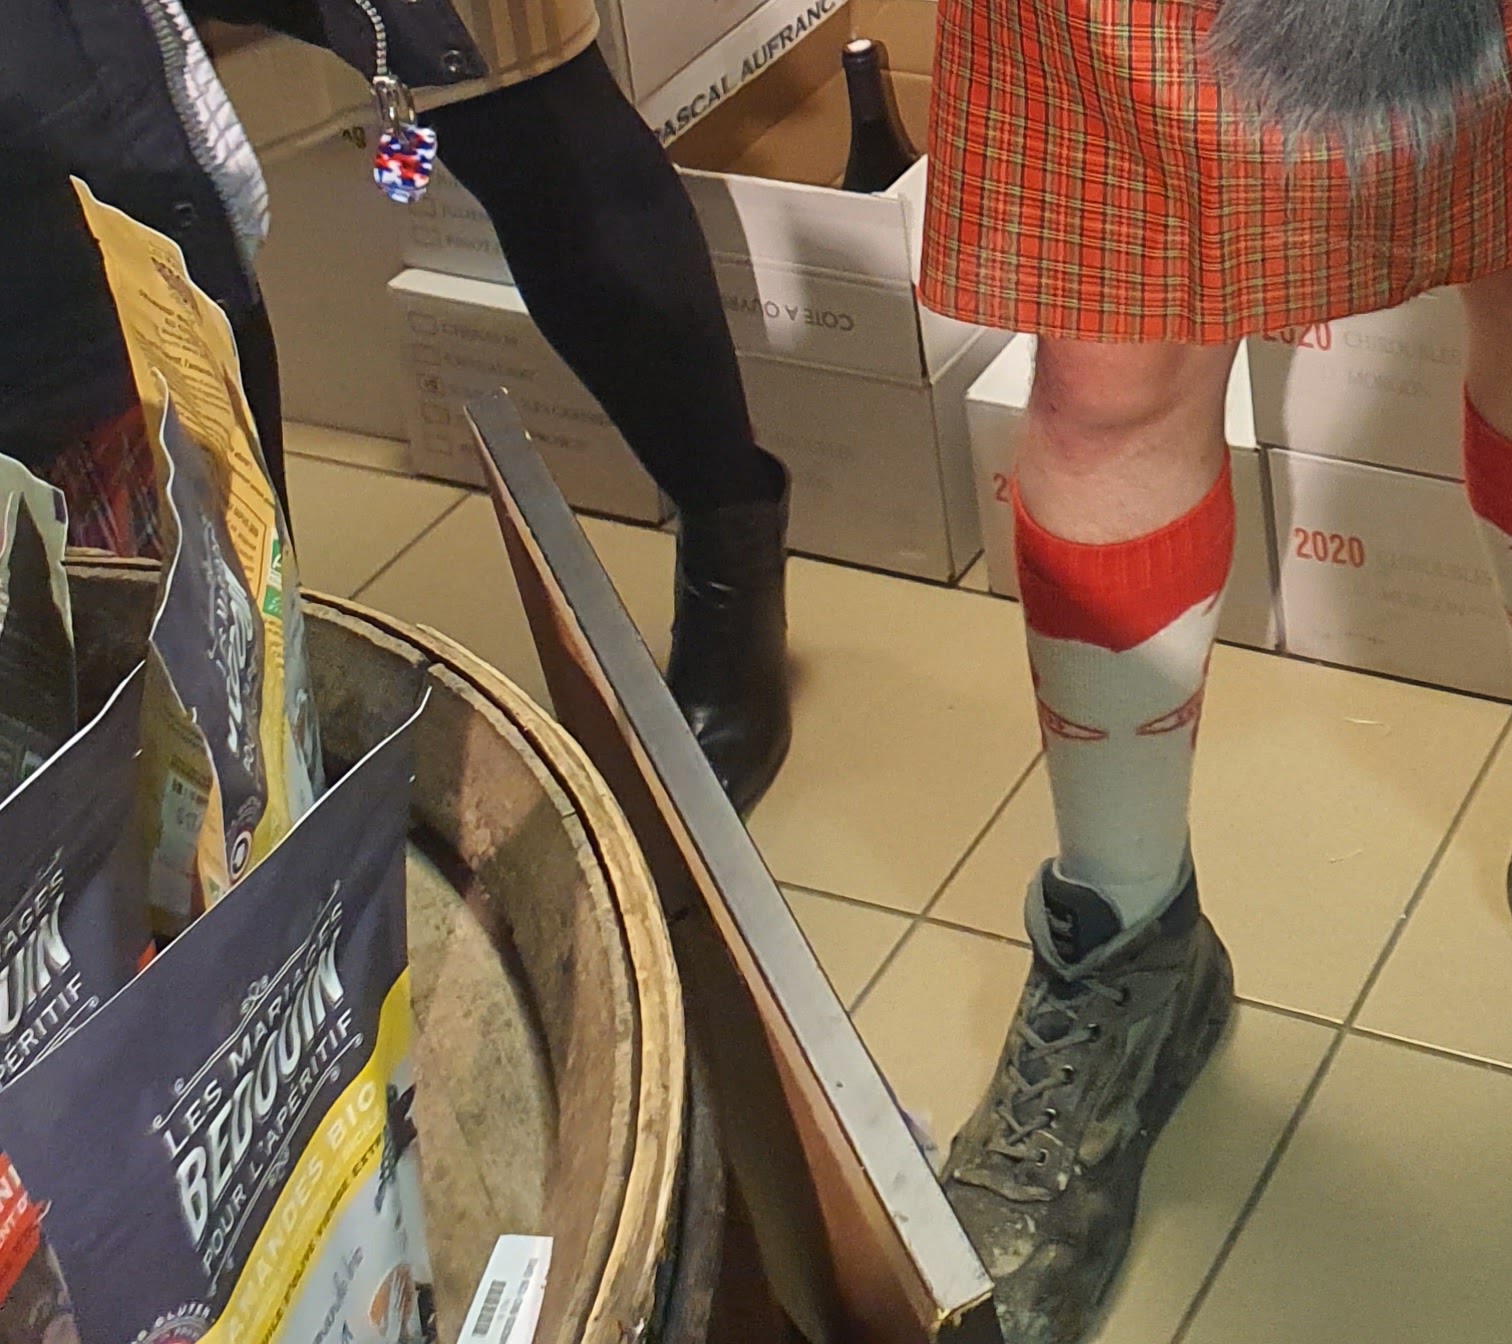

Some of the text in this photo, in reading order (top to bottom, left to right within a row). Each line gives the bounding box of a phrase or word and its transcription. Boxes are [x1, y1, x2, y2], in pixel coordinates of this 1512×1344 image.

[1294, 527, 1366, 569] 2020
[163, 1078, 223, 1160] LES
[326, 1080, 377, 1153] BIO
[202, 1183, 248, 1276] POUR
